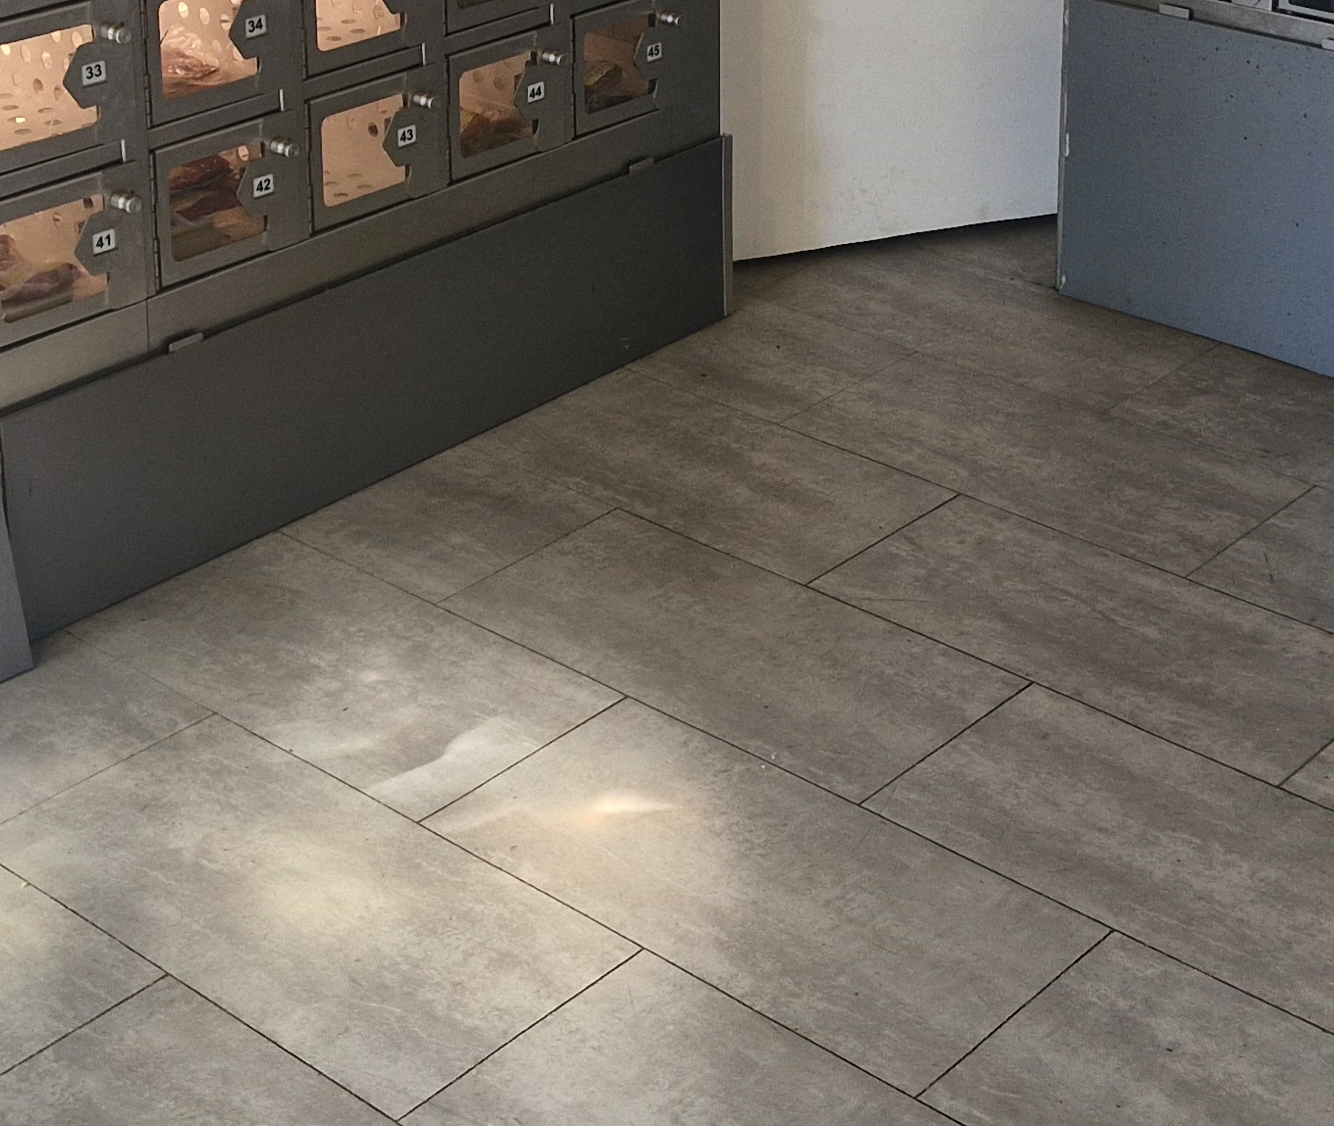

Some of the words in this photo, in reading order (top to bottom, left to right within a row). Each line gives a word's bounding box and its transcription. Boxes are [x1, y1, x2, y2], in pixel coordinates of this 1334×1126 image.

[248, 18, 263, 32] 34
[648, 45, 661, 58] 45
[86, 64, 102, 79] 33
[530, 86, 542, 99] 44
[400, 128, 414, 142] 43
[256, 178, 271, 192] 42
[95, 234, 112, 248] 41
